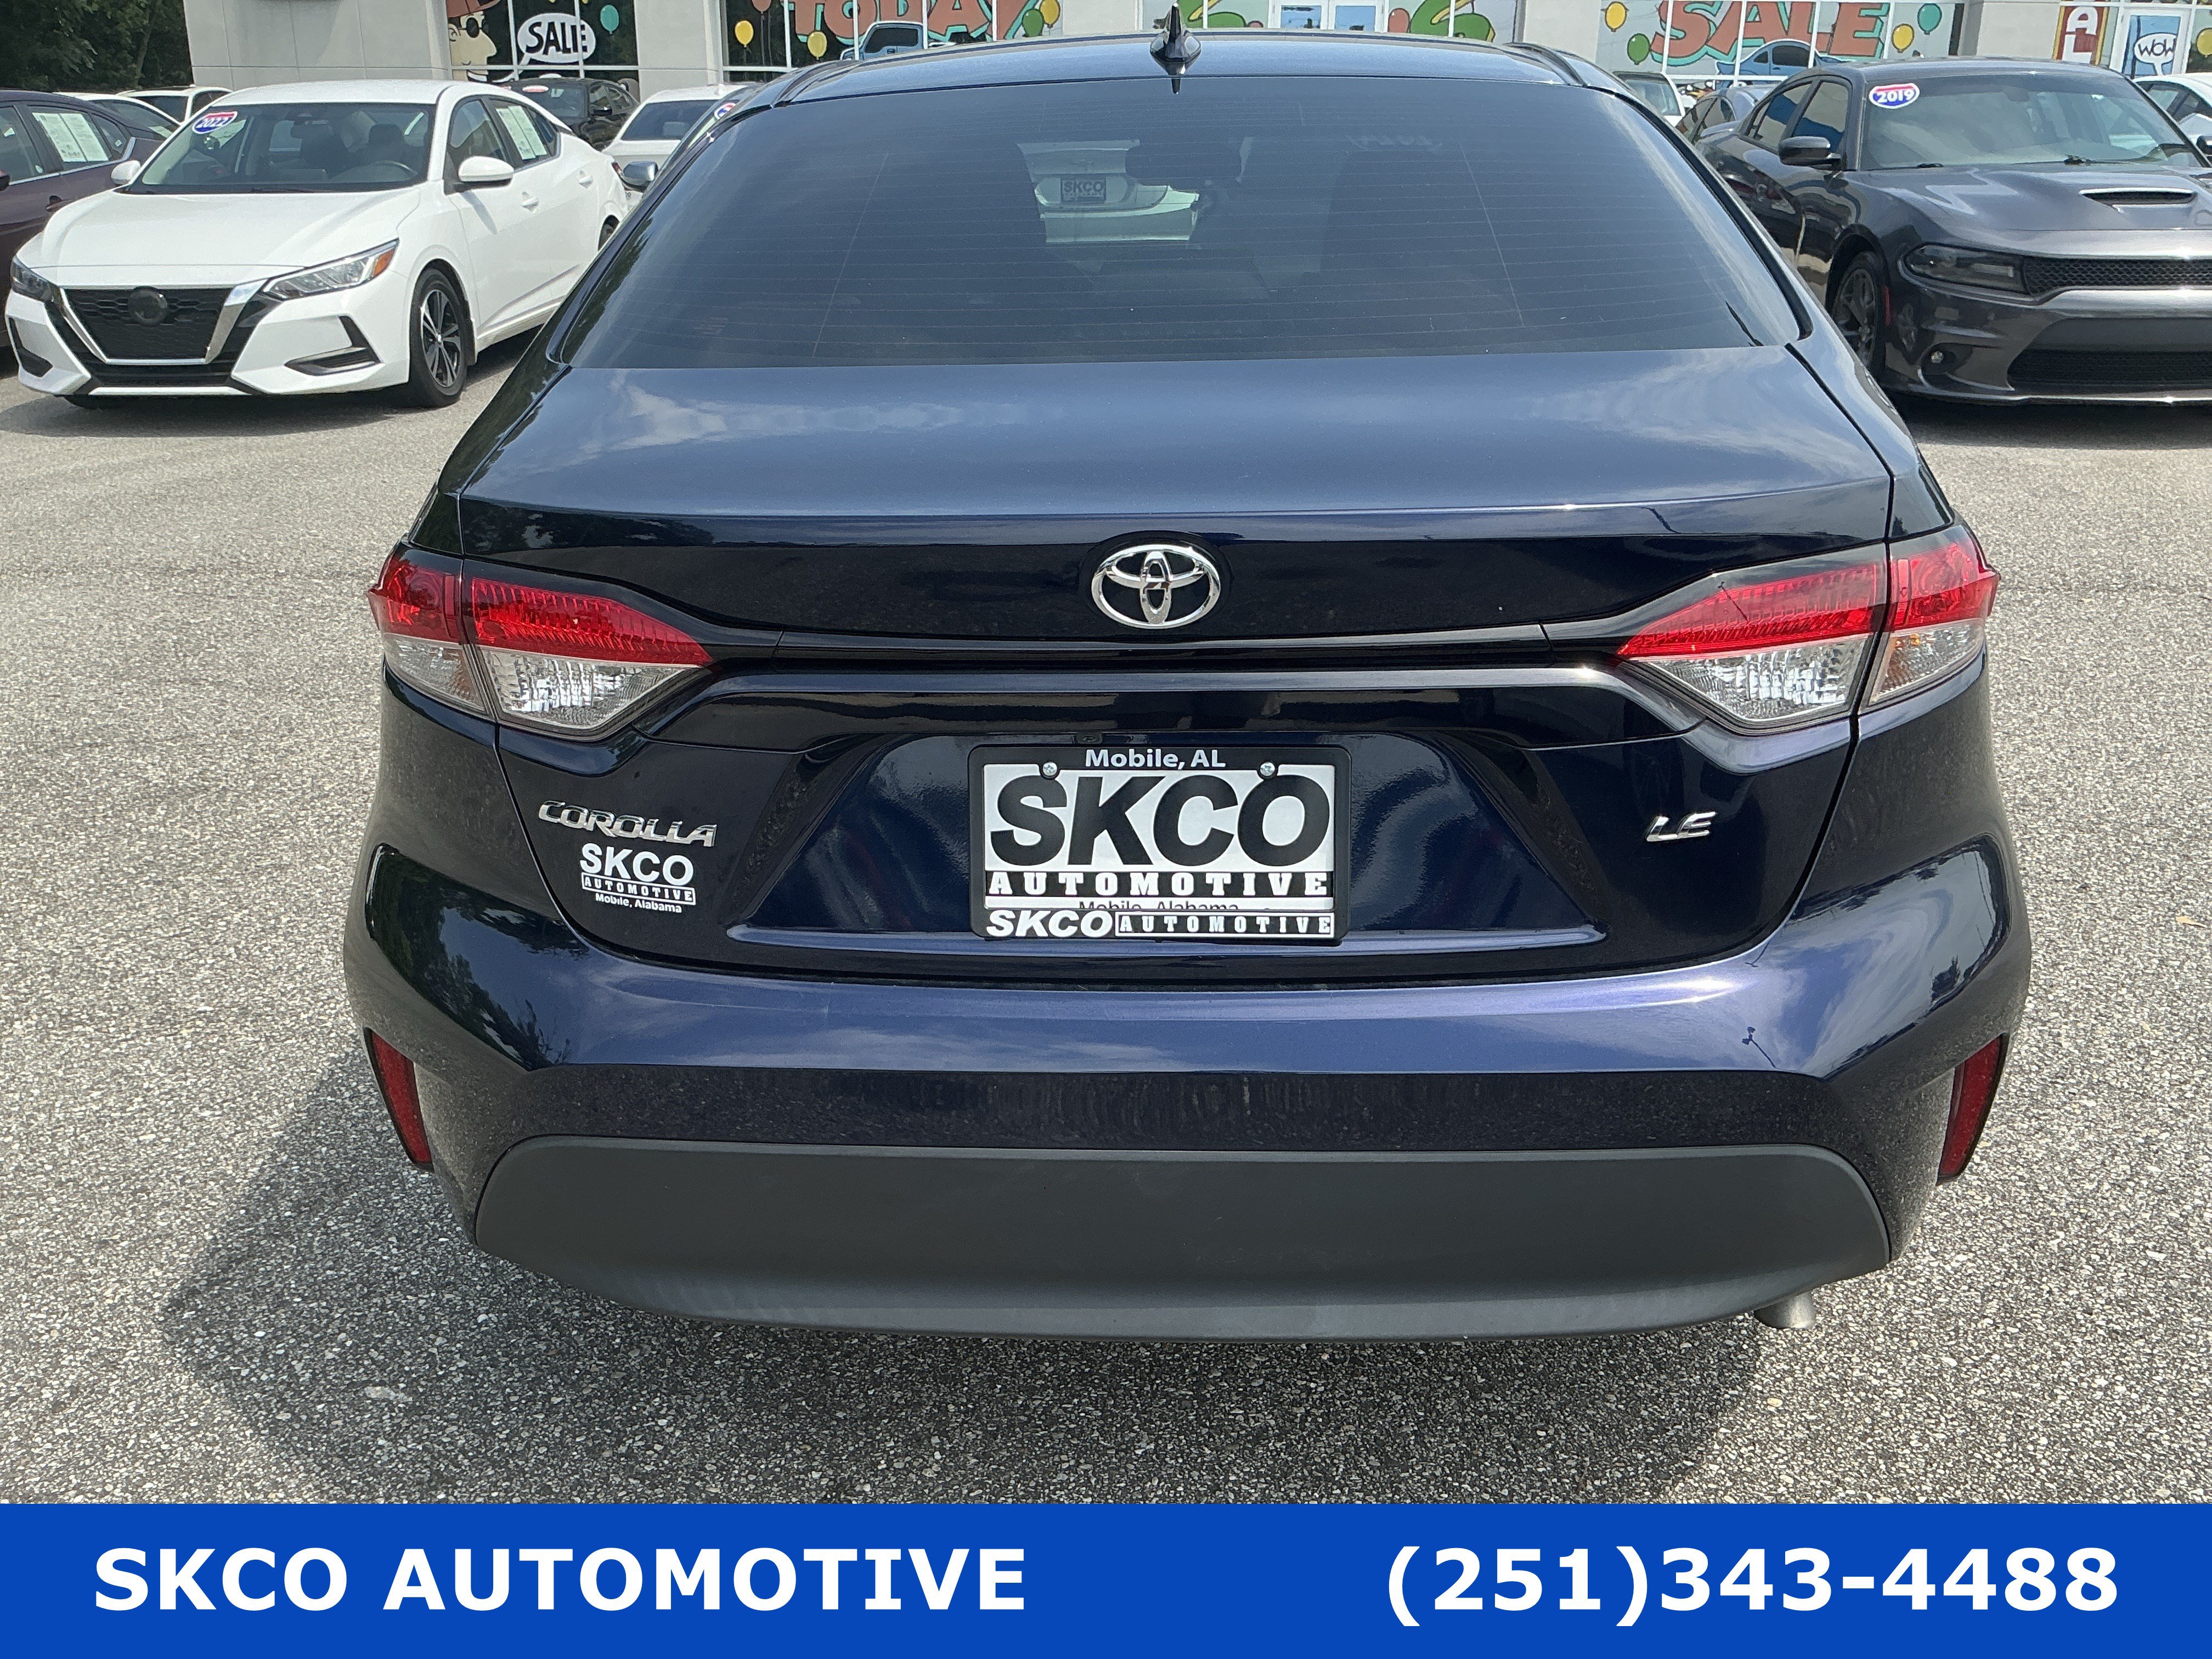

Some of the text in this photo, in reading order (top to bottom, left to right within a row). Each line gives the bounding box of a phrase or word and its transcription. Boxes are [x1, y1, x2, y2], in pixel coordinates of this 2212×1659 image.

[526, 21, 588, 55] SALE
[1651, 1, 1891, 66] SALE
[2138, 38, 2177, 57] WOW
[1876, 89, 1915, 103] 2019
[195, 116, 229, 128] 2022
[1064, 180, 1104, 192] SKCO
[1086, 749, 1226, 770] Mobile, AL
[538, 799, 718, 847] COROLLA
[991, 775, 1330, 867] SKCO
[1645, 811, 1718, 842] LE
[579, 843, 694, 886] SKCO
[584, 876, 693, 901] AUTOMOTIVE
[989, 871, 1328, 896] AUTOMOTIVE
[595, 893, 682, 913] Mobile, Alabama
[986, 910, 1331, 938] SKCO AUTOMOTIVE
